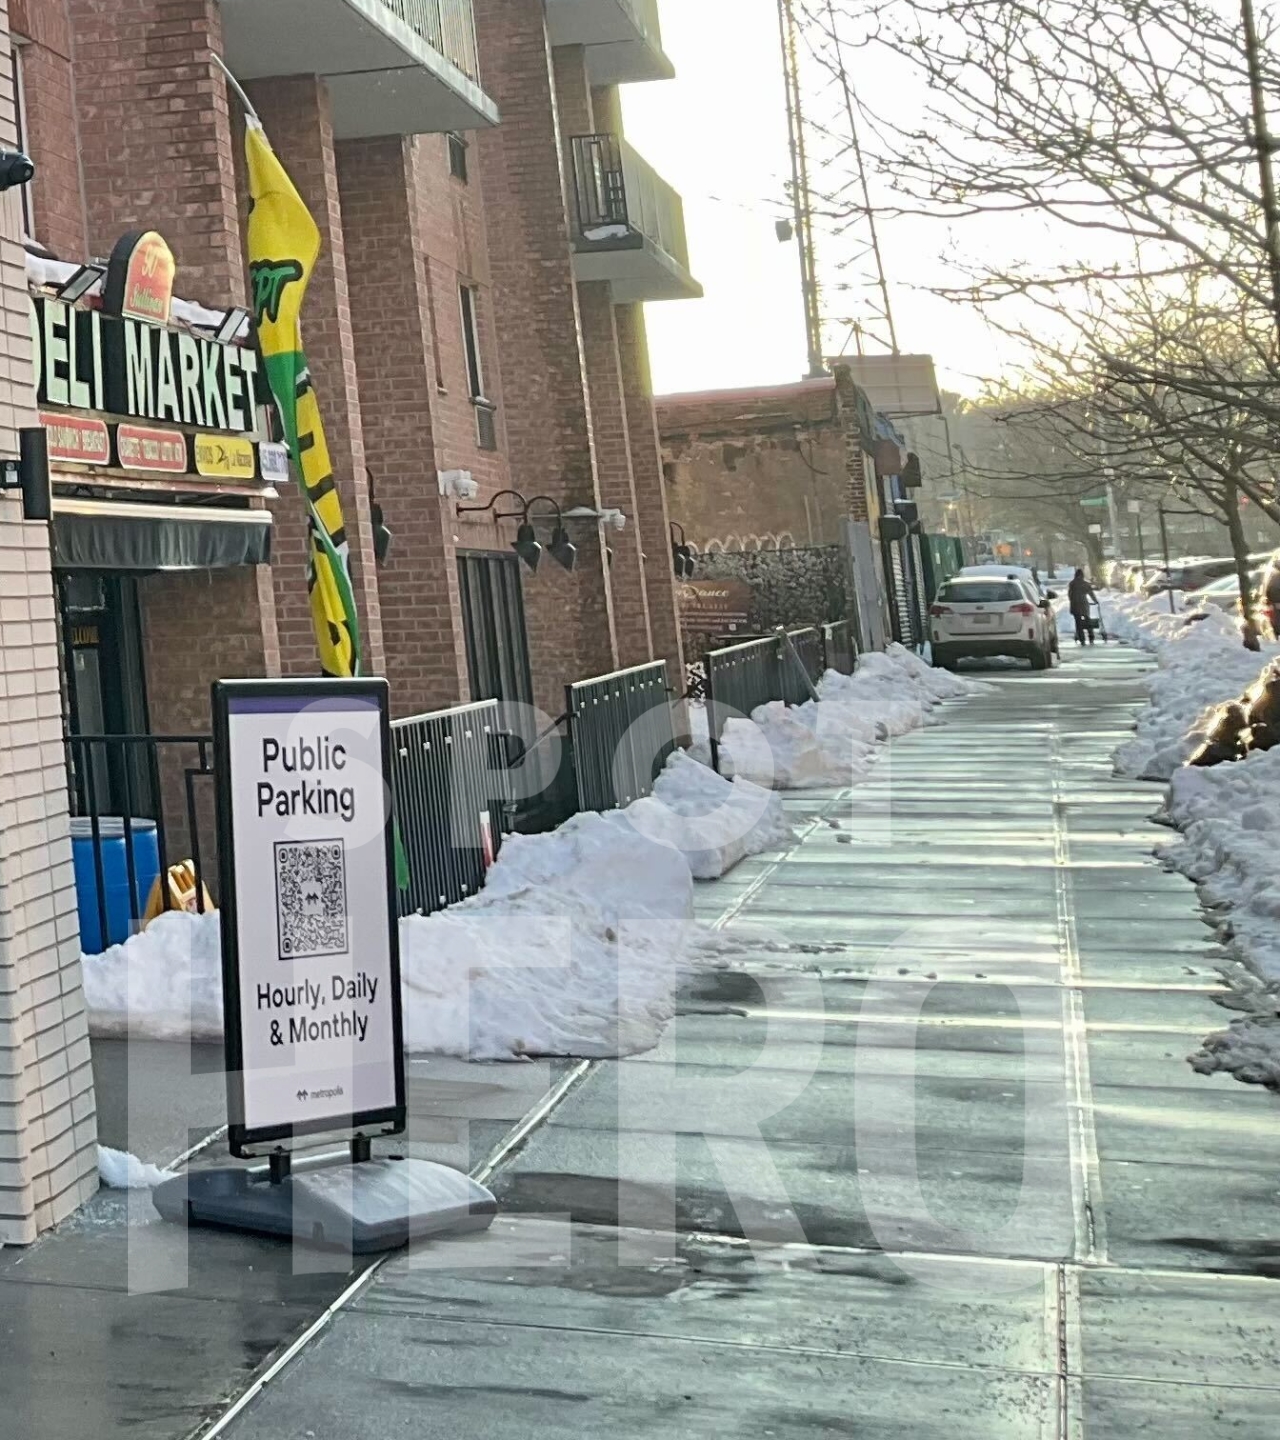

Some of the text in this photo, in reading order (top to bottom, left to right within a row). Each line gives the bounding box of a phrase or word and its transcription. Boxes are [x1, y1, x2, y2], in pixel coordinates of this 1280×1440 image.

[29, 296, 258, 433] ELI MARKET
[263, 737, 347, 773] Public
[256, 782, 356, 823] Parking
[257, 972, 379, 1011] Hourly, Daily
[270, 1011, 369, 1045] & Monthly
